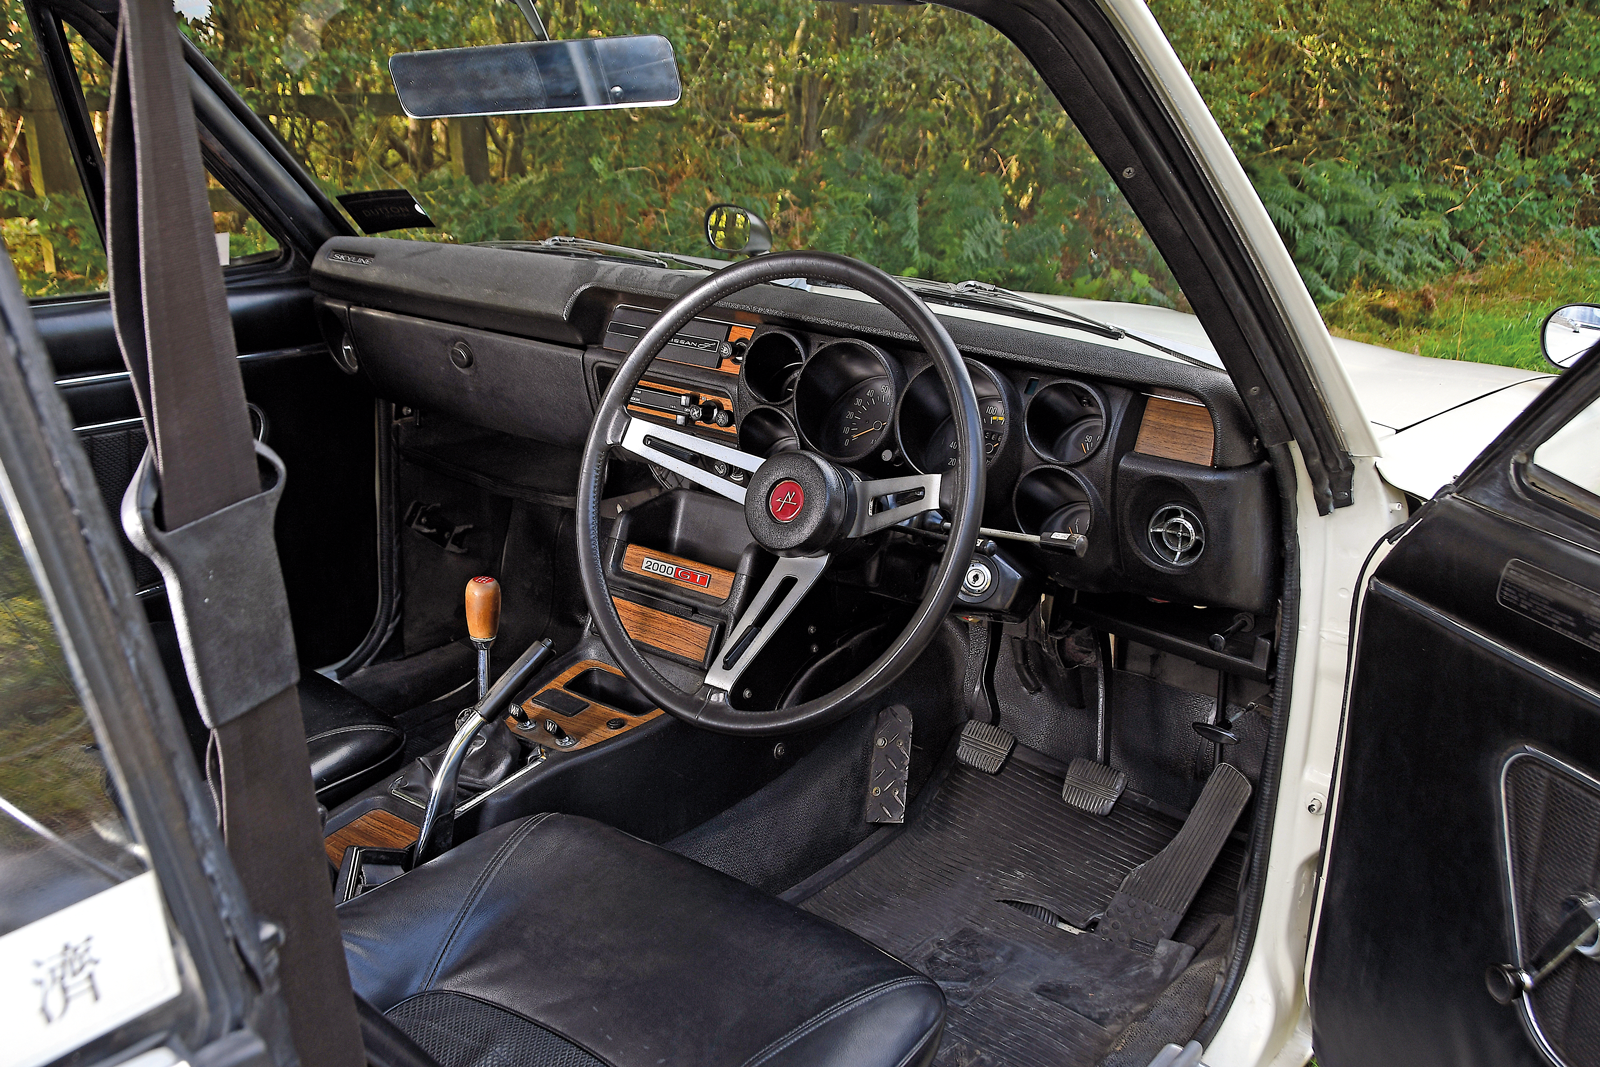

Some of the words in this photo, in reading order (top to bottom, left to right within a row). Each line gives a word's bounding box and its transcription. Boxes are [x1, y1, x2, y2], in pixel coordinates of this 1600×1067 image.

[333, 253, 374, 265] SKYLINE
[866, 389, 875, 398] 40
[853, 397, 863, 407] 30
[845, 410, 855, 420] 20
[985, 405, 998, 415] 100
[842, 426, 851, 435] 10
[844, 438, 850, 447] 0
[948, 440, 958, 450] 40
[947, 457, 957, 467] 20
[644, 560, 674, 576] 2000
[677, 569, 707, 583] GT
